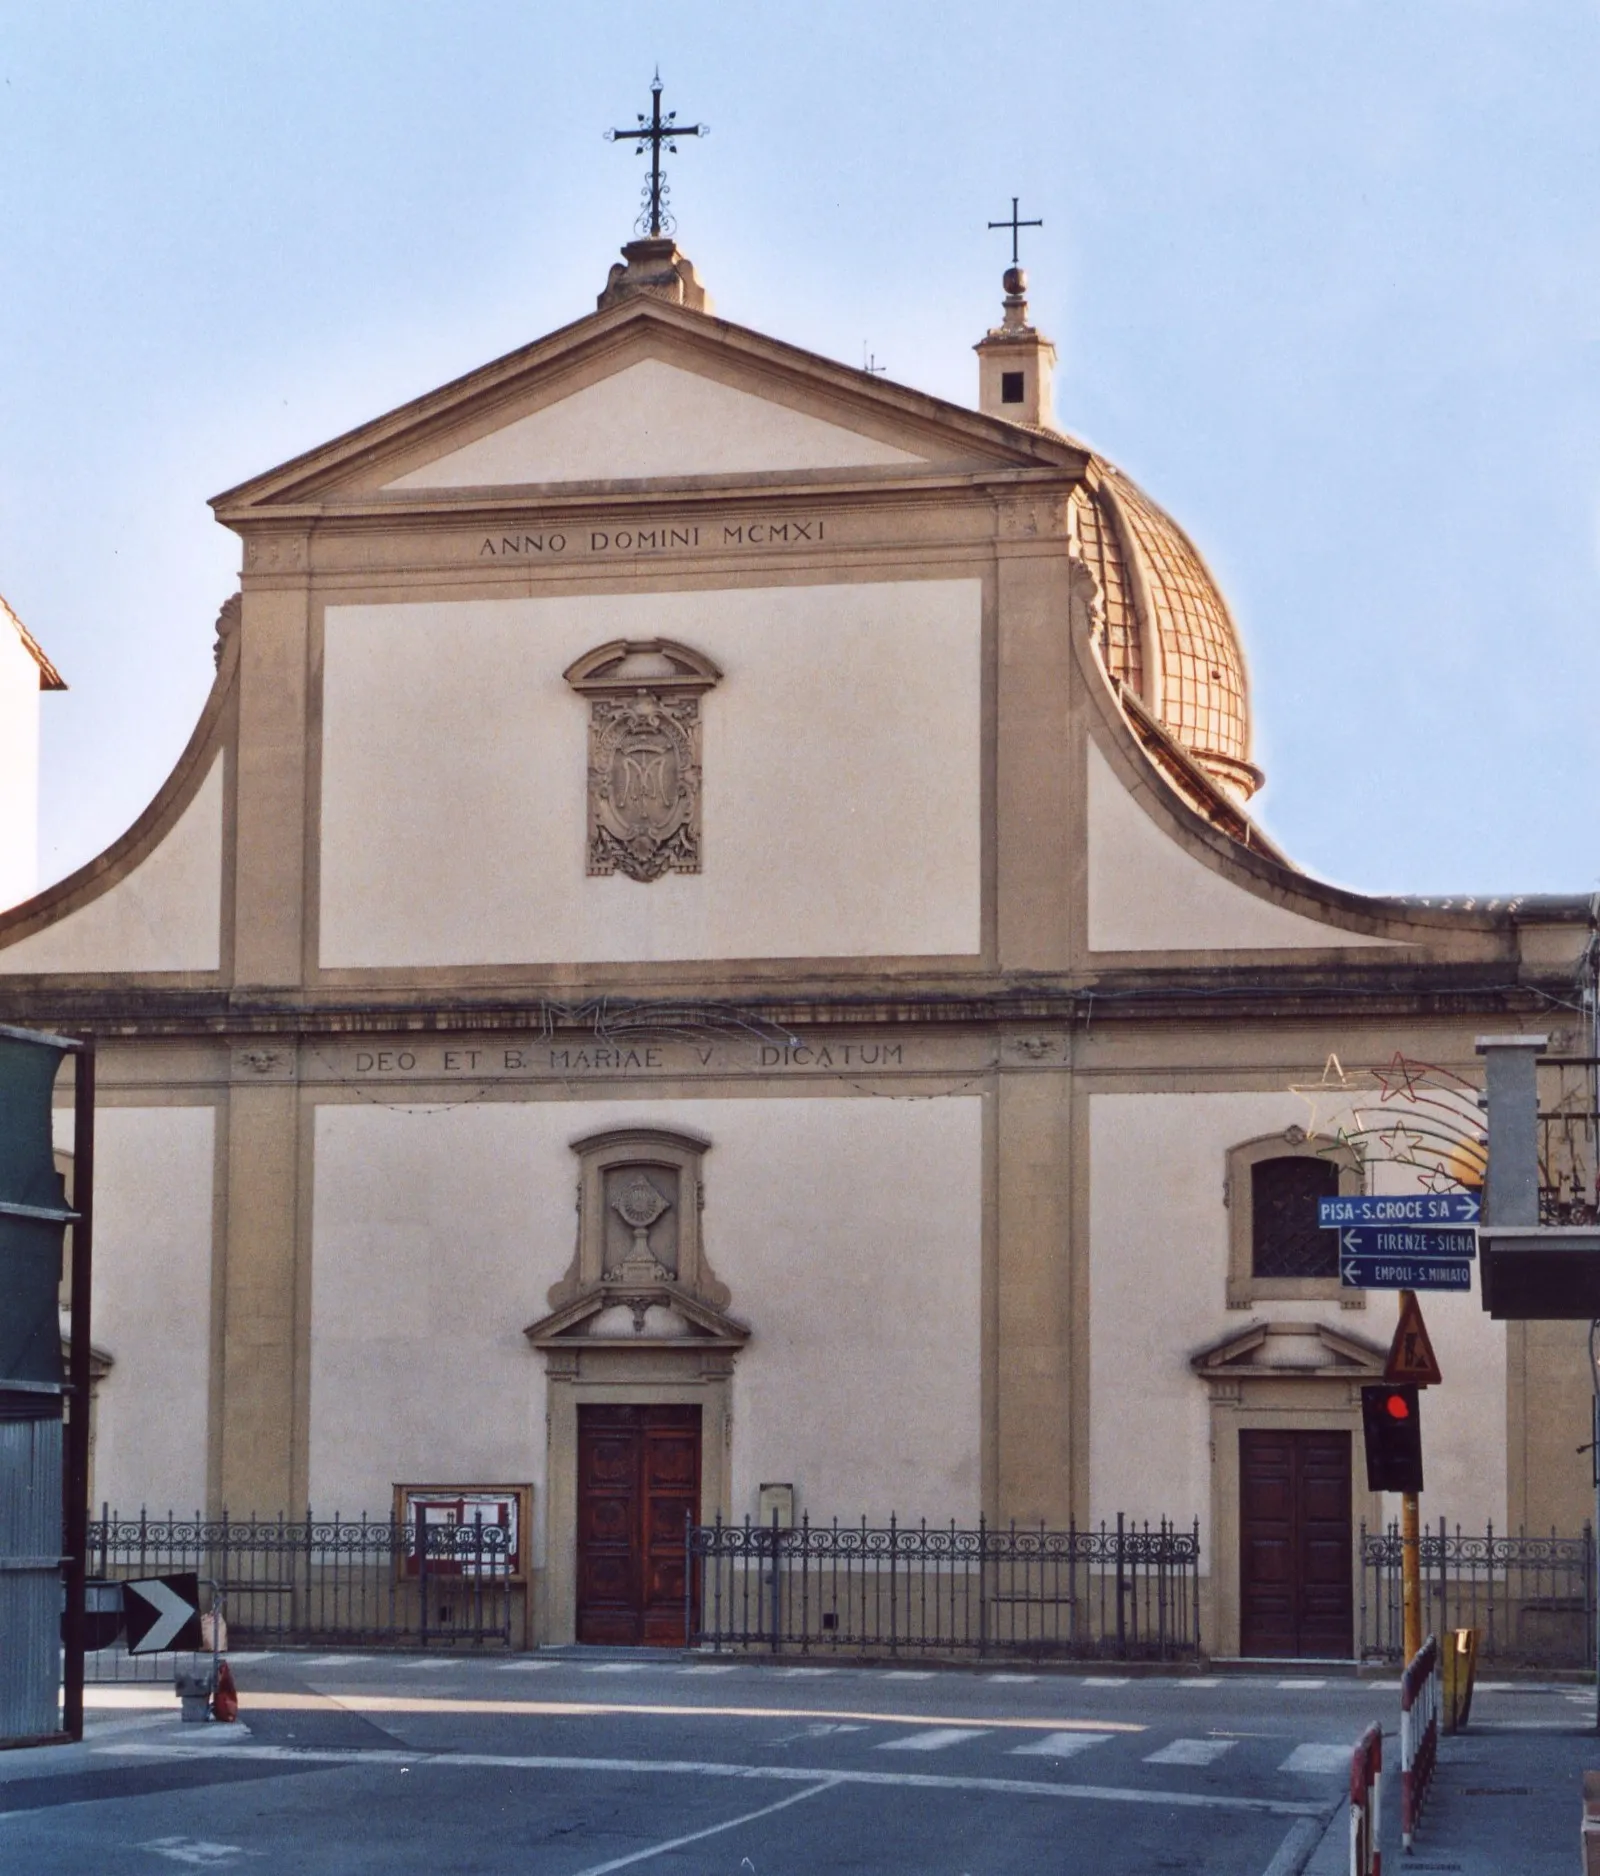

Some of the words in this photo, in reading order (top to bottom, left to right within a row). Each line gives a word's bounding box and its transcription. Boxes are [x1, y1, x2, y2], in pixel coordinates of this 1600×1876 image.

[480, 534, 566, 555] ANNO
[591, 527, 699, 551] DOMINI
[724, 521, 823, 544] MCMXI
[356, 1052, 416, 1072] DEO
[444, 1050, 482, 1070] ET
[503, 1049, 527, 1069] B.
[550, 1048, 663, 1068] MARIAE
[762, 1044, 902, 1067] DICATUM
